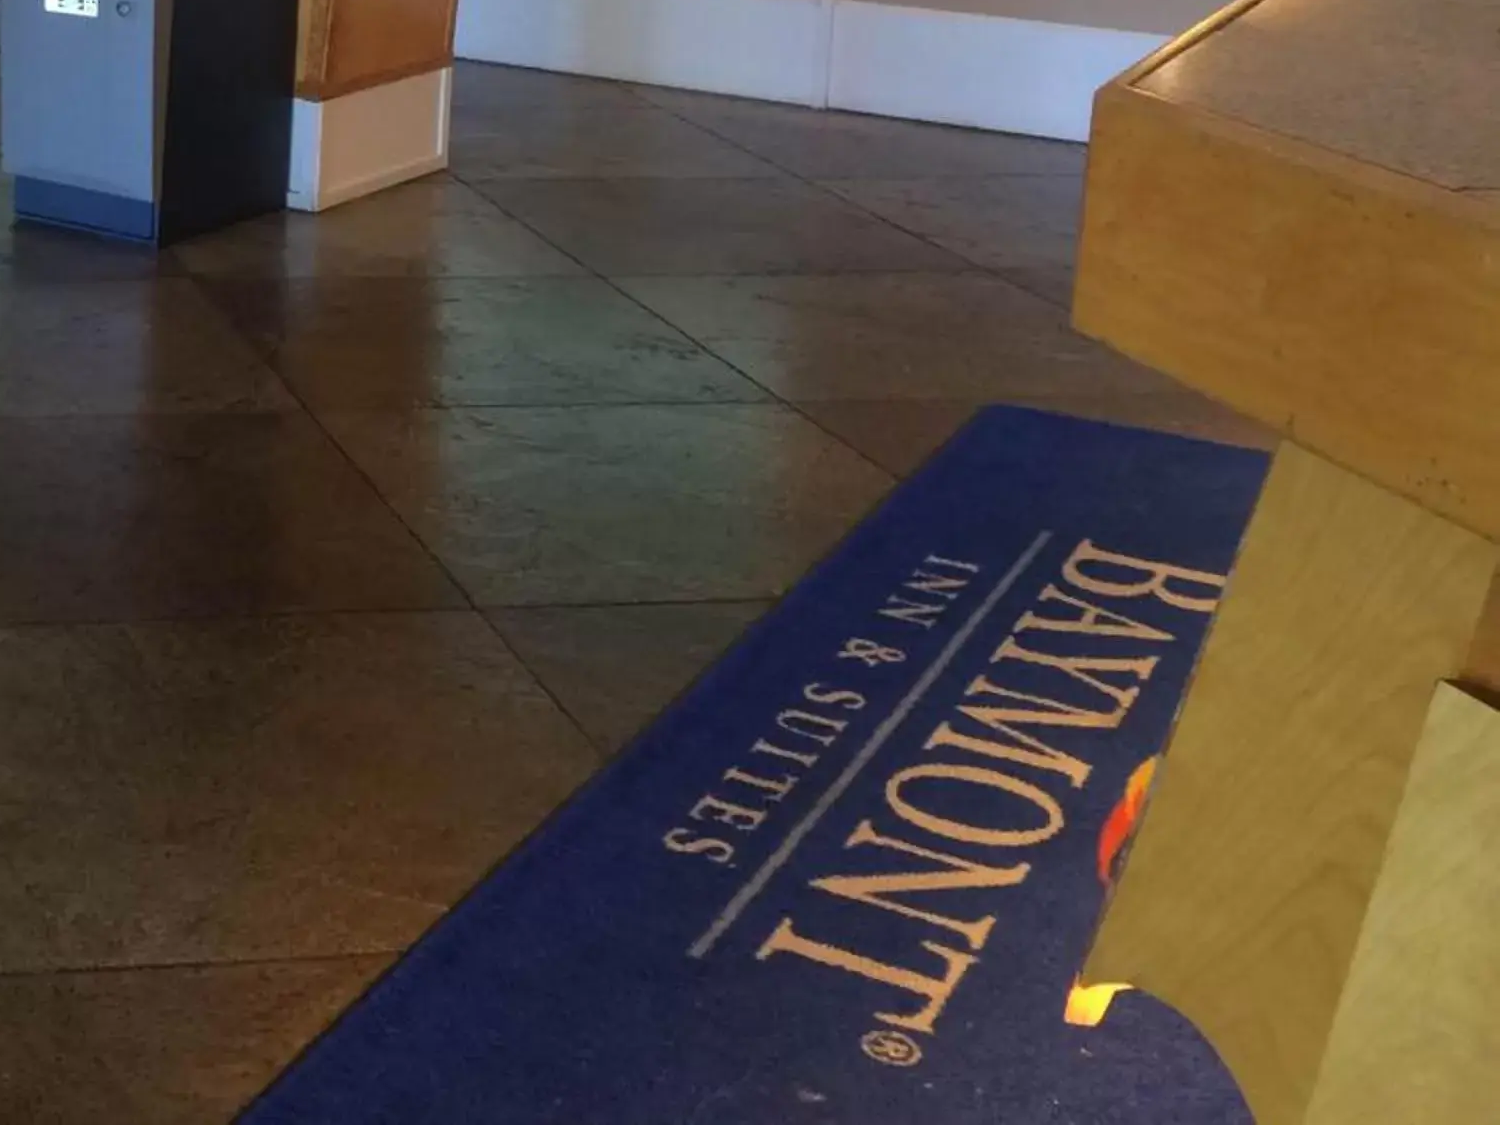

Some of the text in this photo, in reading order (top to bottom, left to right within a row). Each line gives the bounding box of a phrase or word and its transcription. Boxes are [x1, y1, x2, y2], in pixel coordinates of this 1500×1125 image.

[662, 554, 980, 864] INN & SUITES
[755, 539, 1227, 1035] BAYMONT
